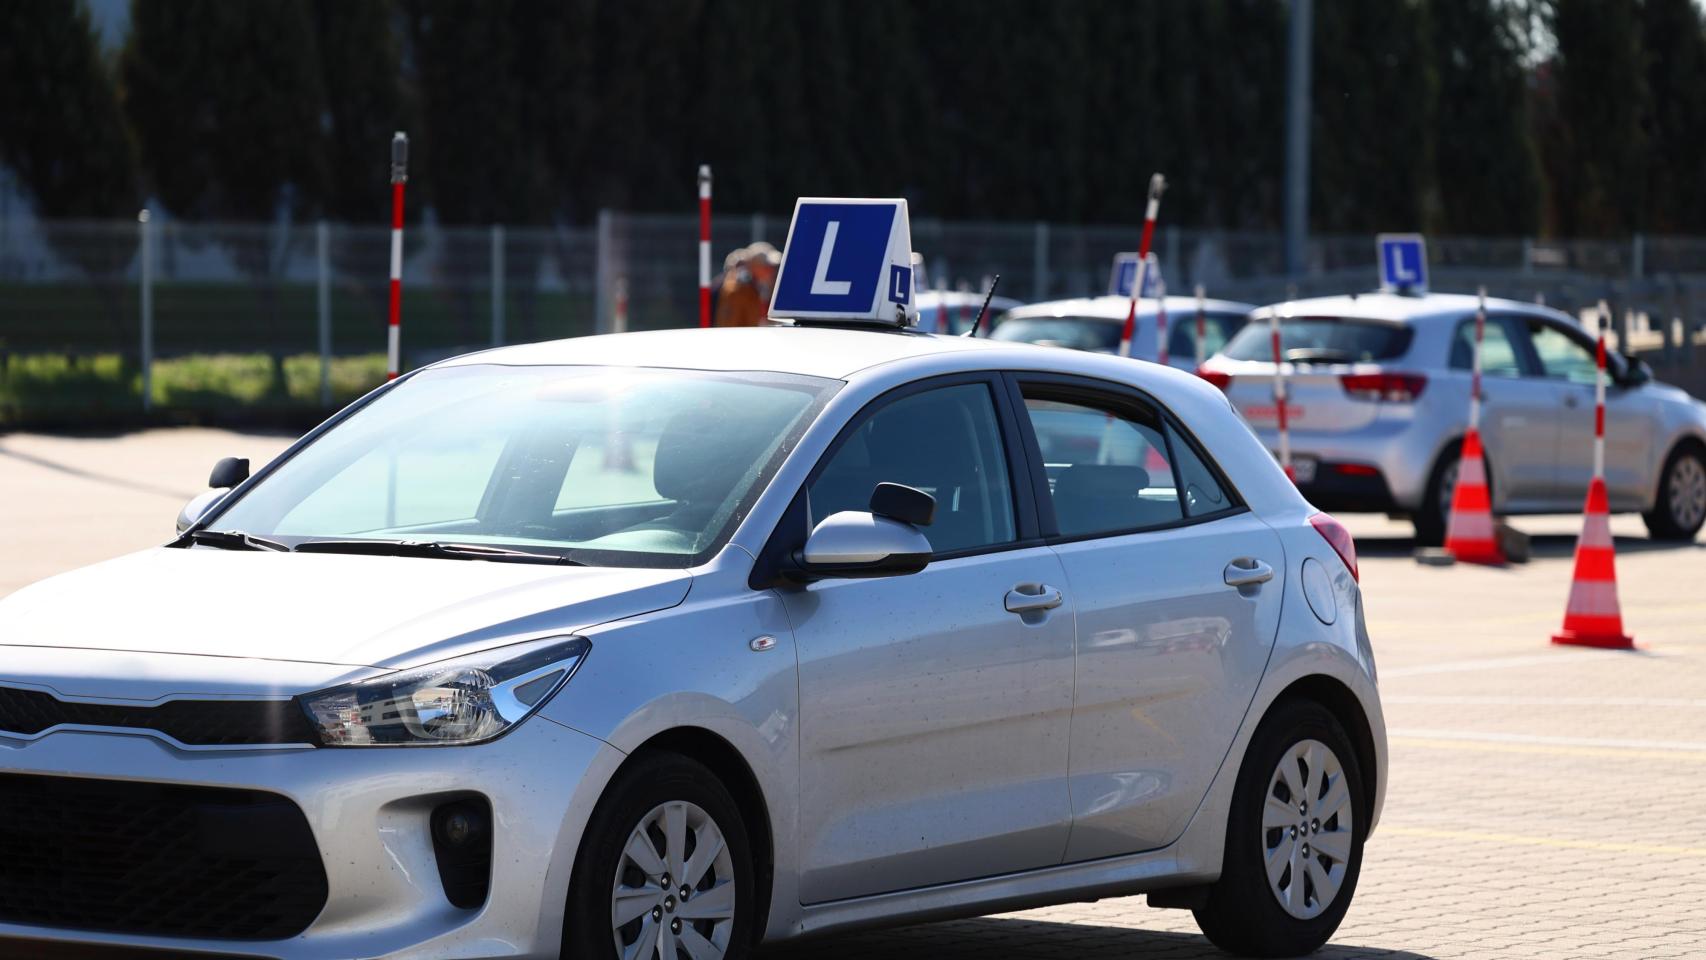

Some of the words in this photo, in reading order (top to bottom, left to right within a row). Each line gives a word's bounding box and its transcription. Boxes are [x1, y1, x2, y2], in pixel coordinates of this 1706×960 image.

[810, 221, 852, 295] L
[1392, 247, 1417, 280] L
[895, 271, 905, 298] L
